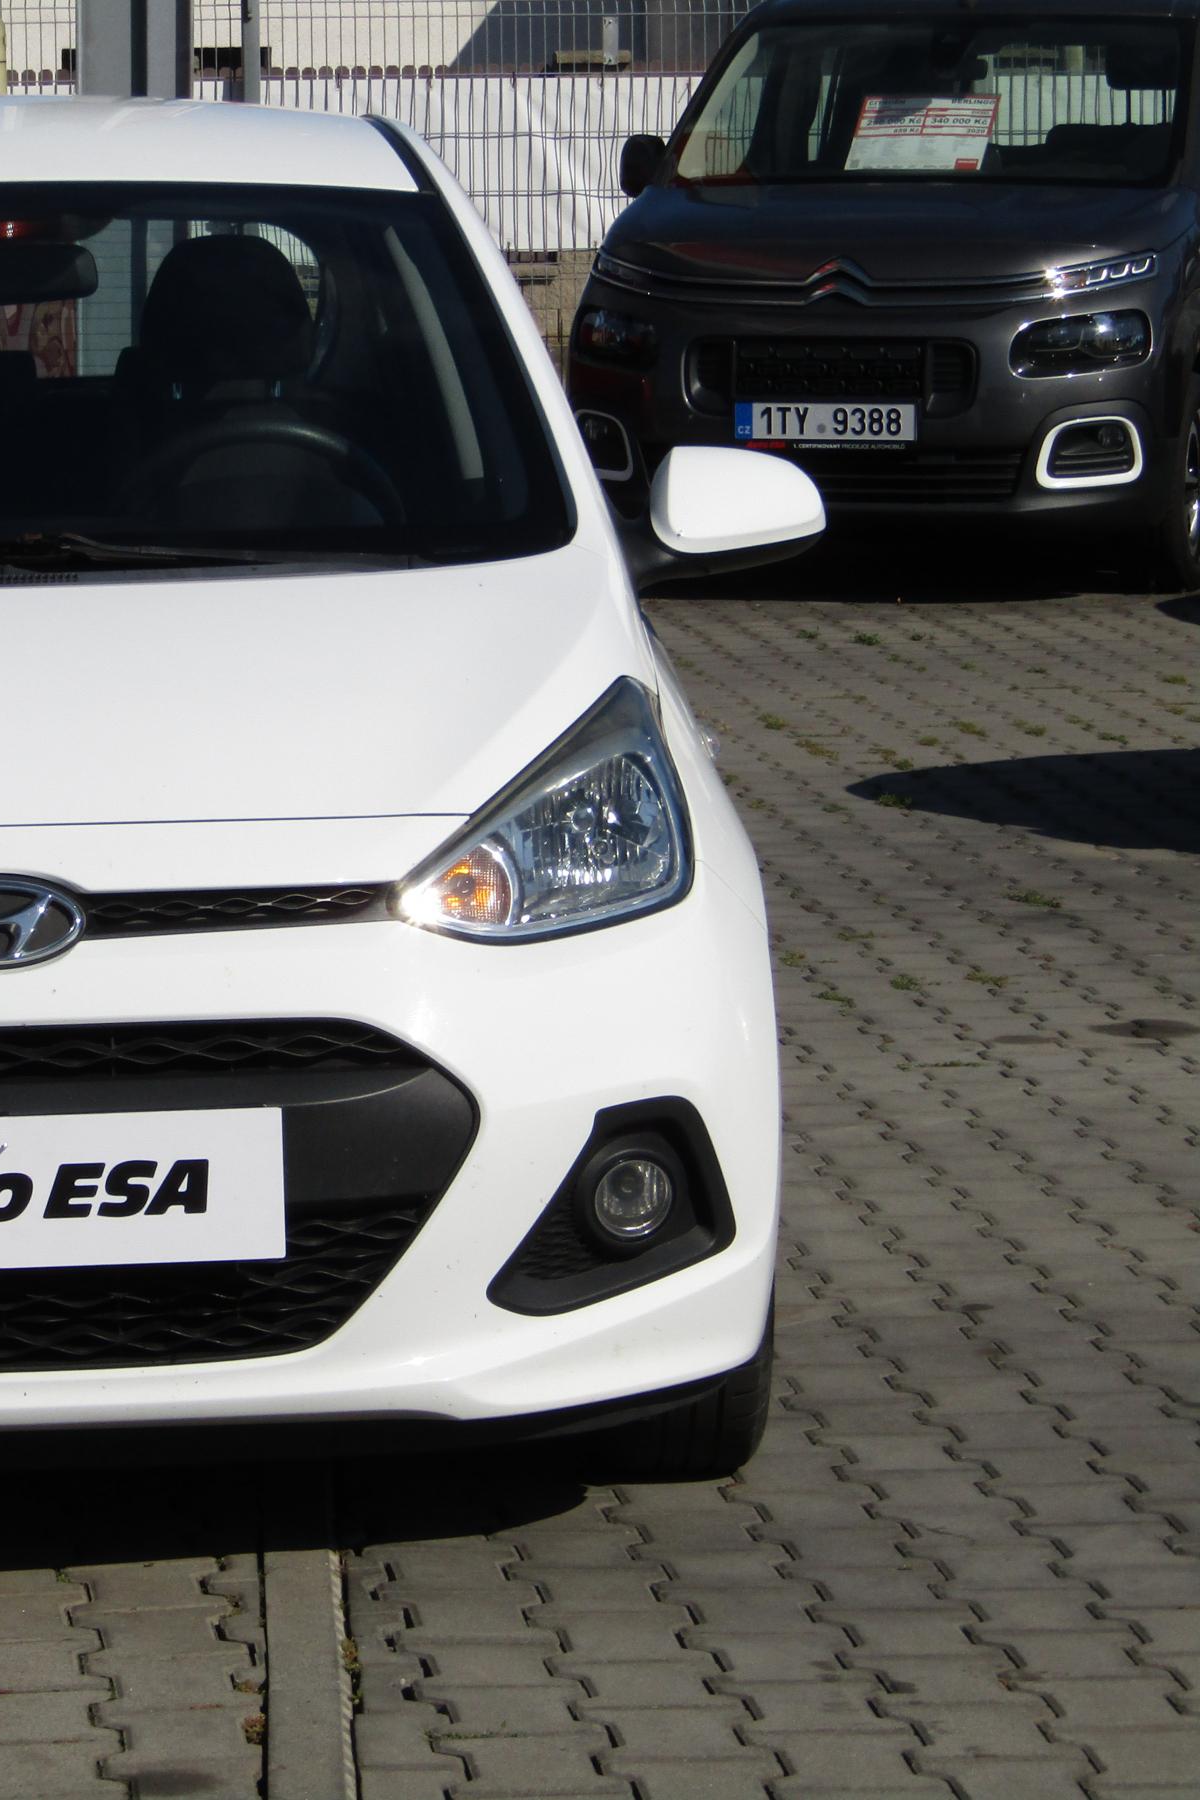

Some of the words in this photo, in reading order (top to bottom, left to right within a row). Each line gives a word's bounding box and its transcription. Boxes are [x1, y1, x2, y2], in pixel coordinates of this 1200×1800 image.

[952, 117, 971, 125] 000
[737, 425, 751, 434] CZ
[760, 406, 810, 435] 1TY
[832, 407, 902, 436] 9388
[43, 1159, 210, 1219] ESA
